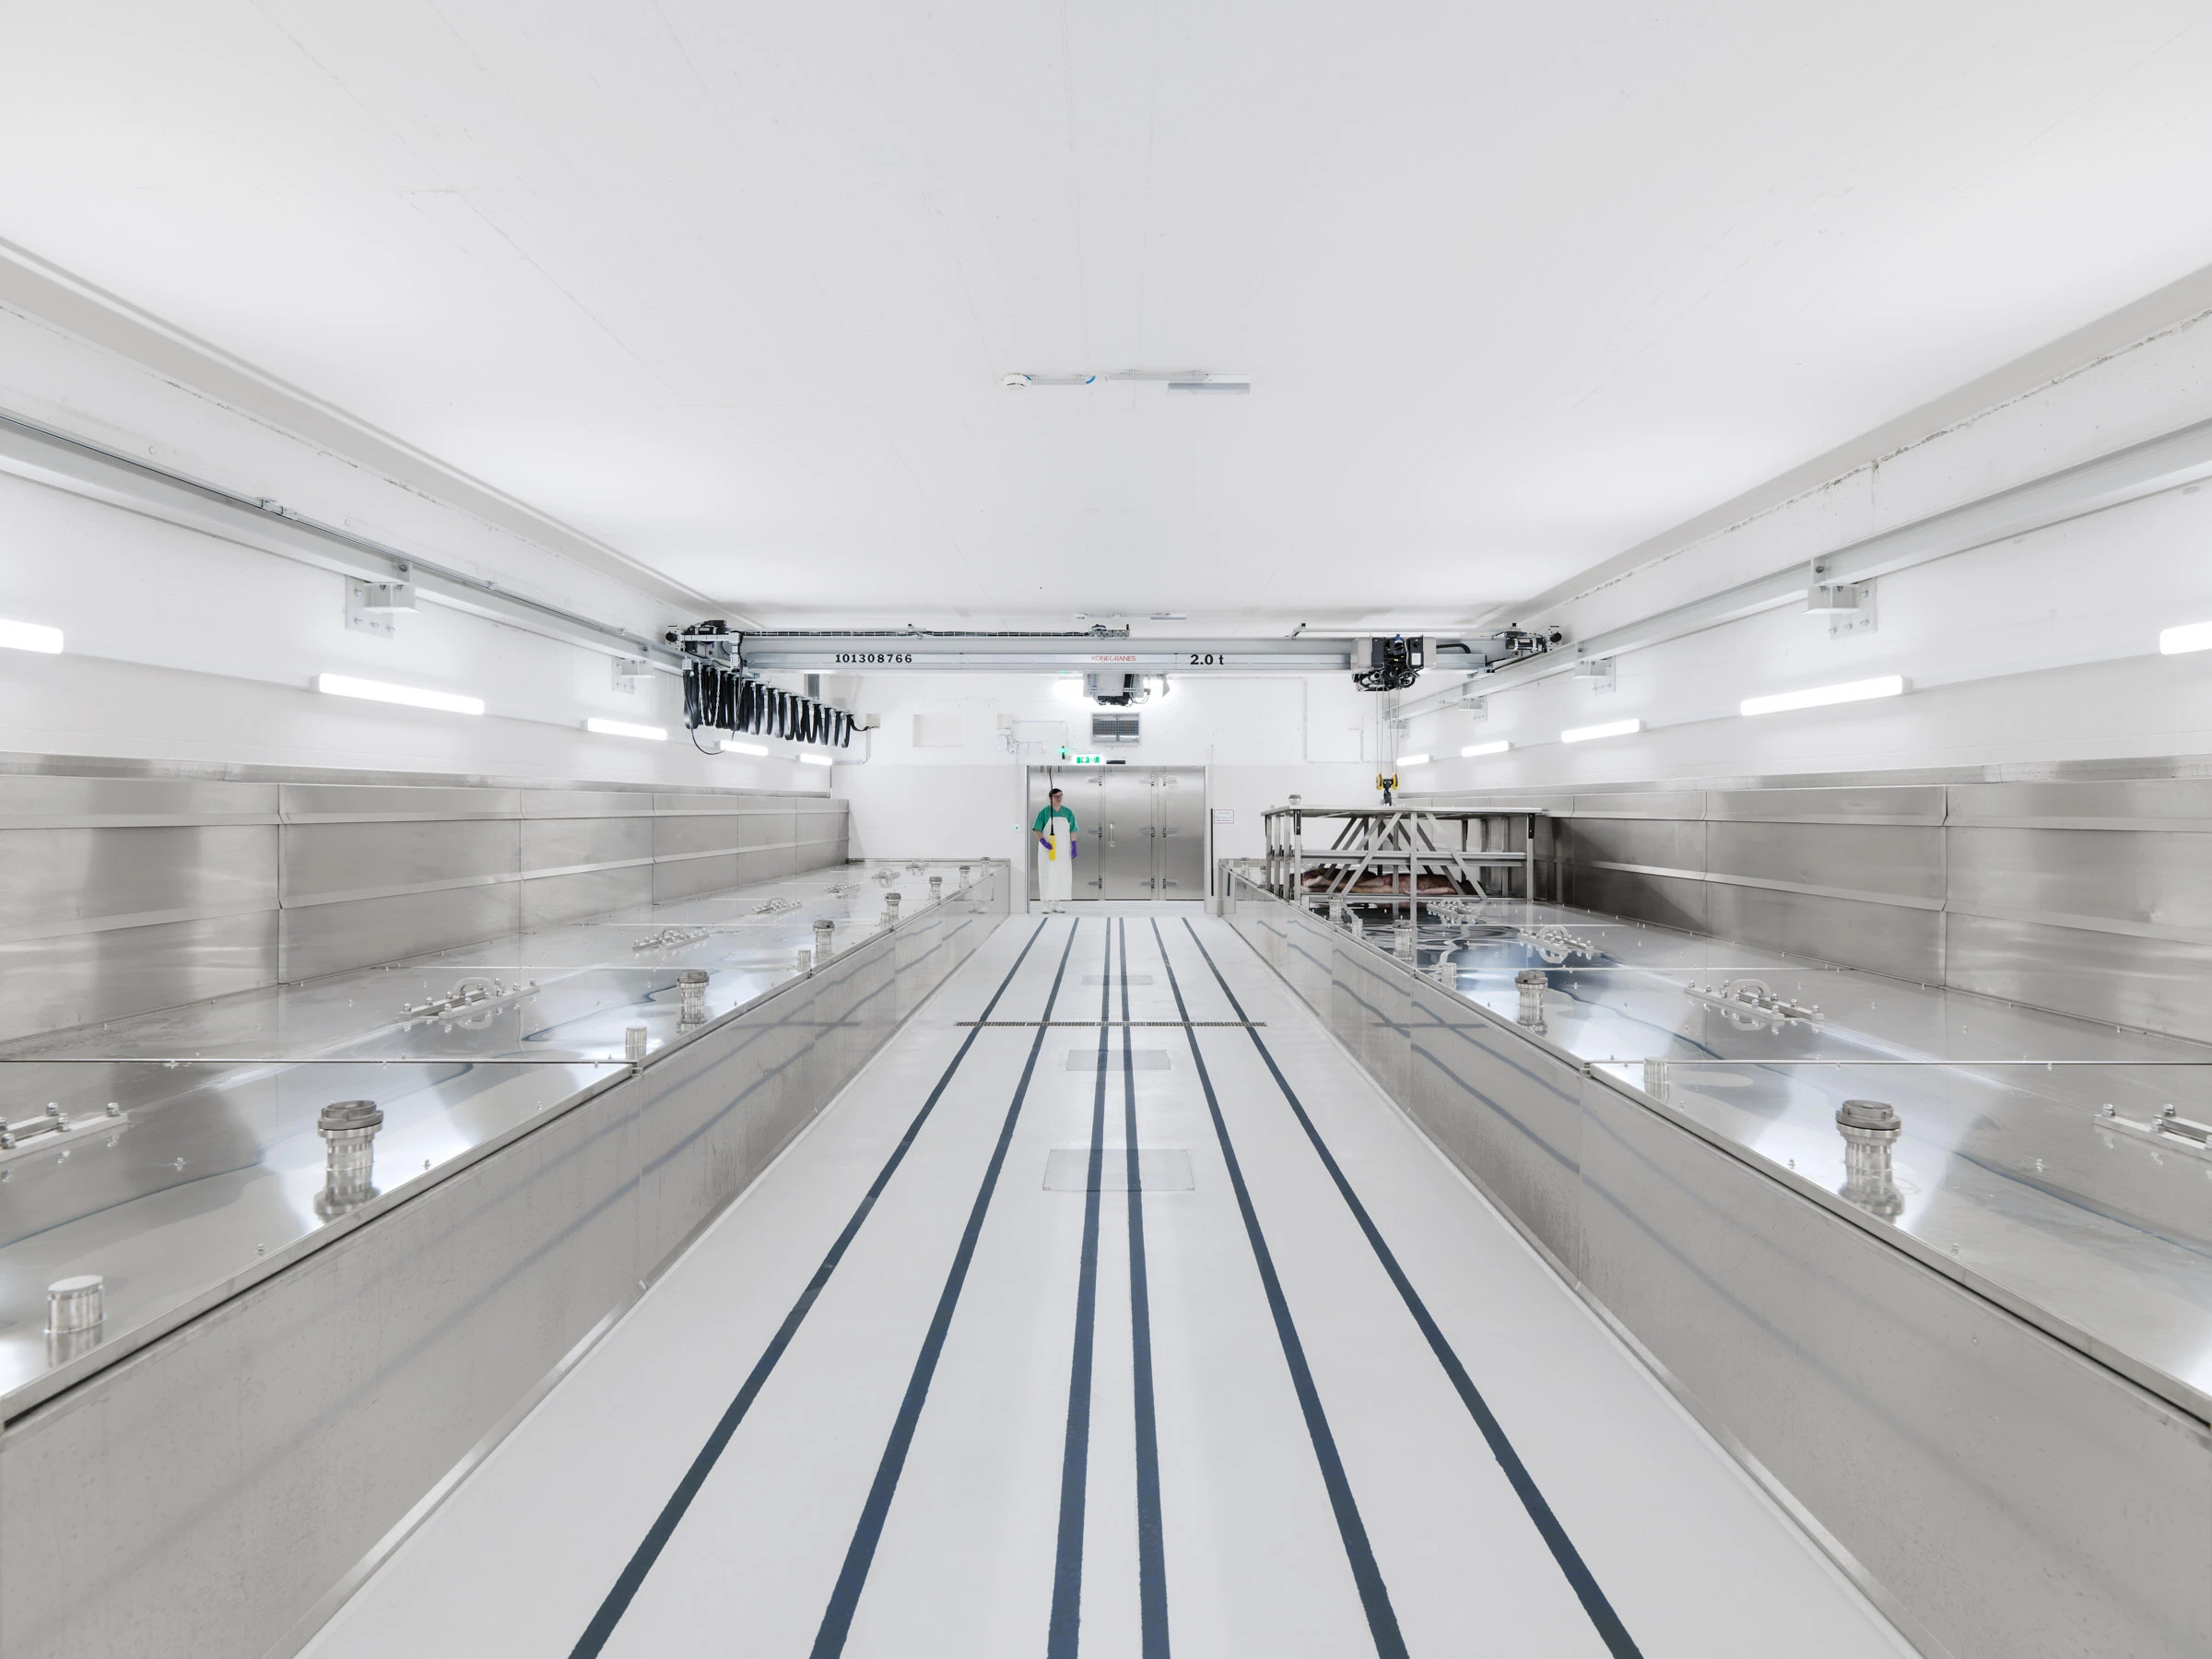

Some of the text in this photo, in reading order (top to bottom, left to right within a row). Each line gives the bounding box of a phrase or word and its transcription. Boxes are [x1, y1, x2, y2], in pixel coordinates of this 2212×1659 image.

[835, 653, 912, 664] 101308766
[1190, 653, 1224, 665] 2.0 t
